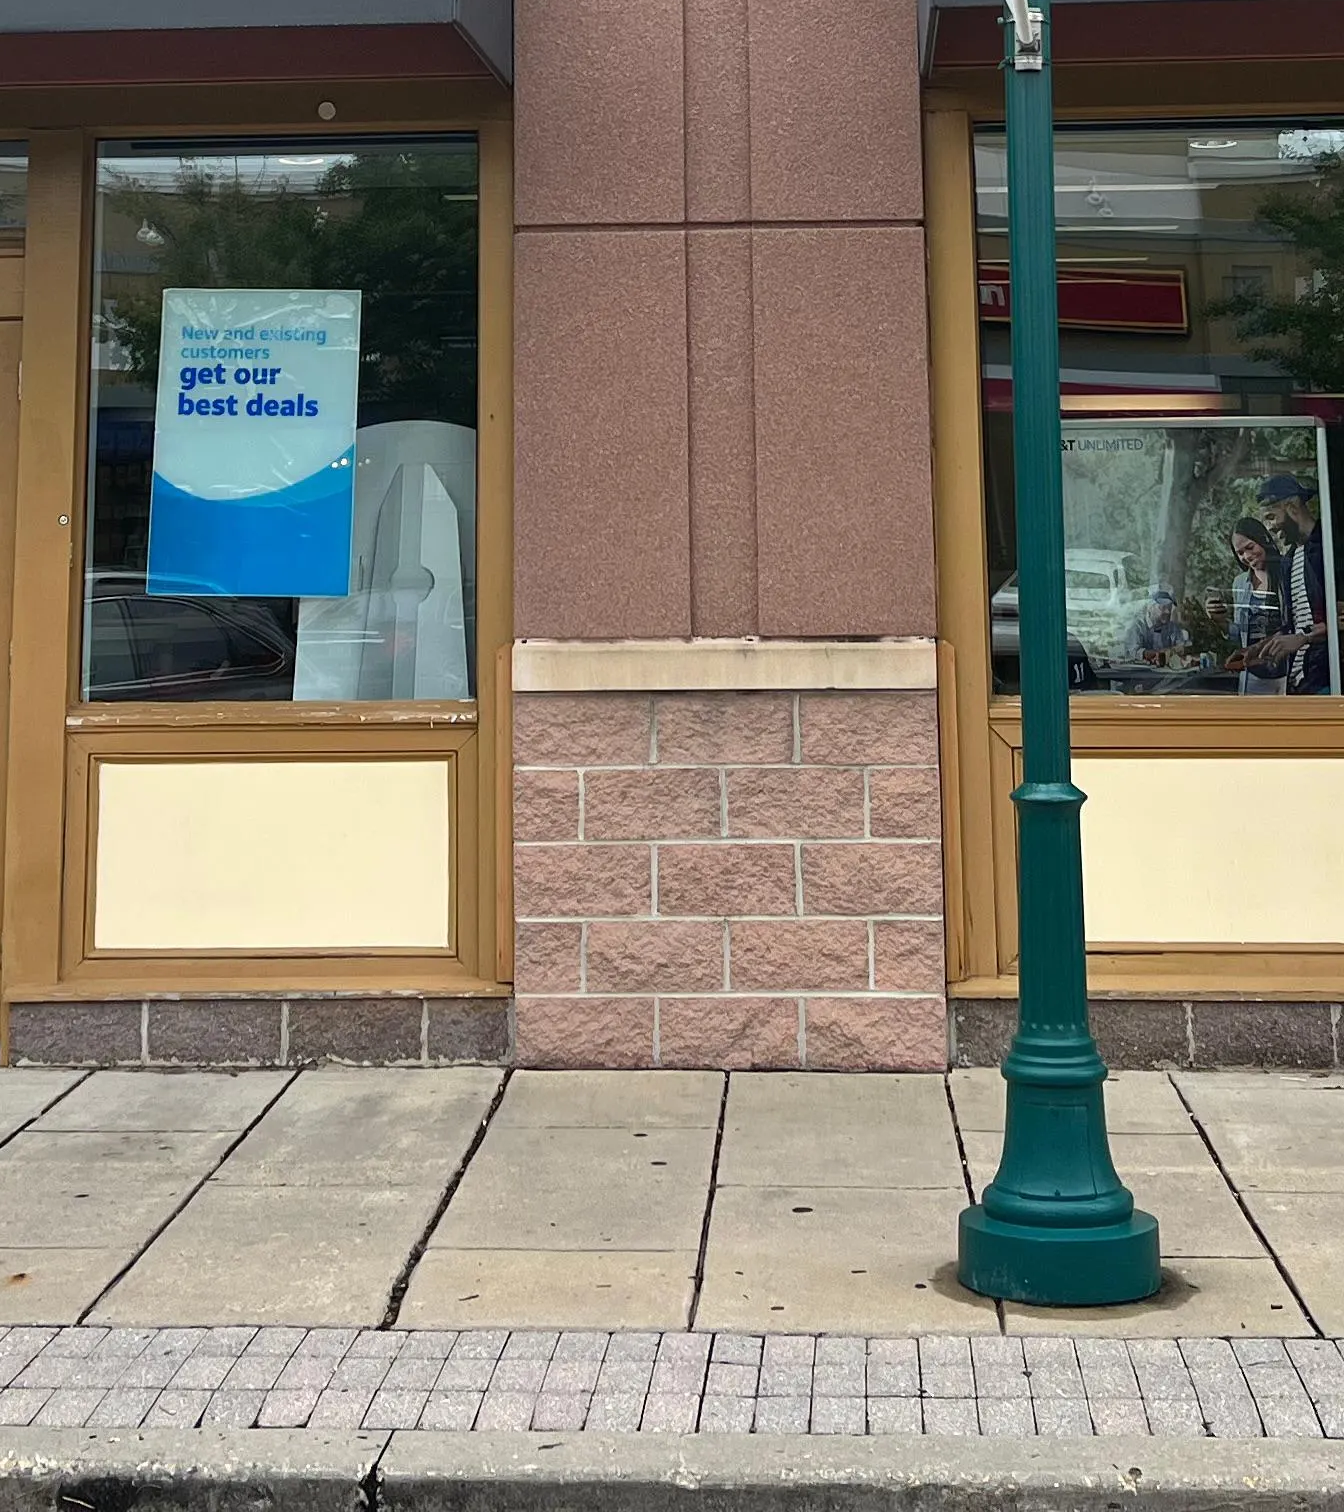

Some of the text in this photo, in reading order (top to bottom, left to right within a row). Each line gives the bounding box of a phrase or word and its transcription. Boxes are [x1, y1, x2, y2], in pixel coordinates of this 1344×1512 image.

[181, 326, 327, 345] New and existing
[180, 345, 270, 360] customers
[179, 363, 282, 390] get our
[177, 392, 319, 417] best deals
[1077, 437, 1144, 452] UNLIMITED
